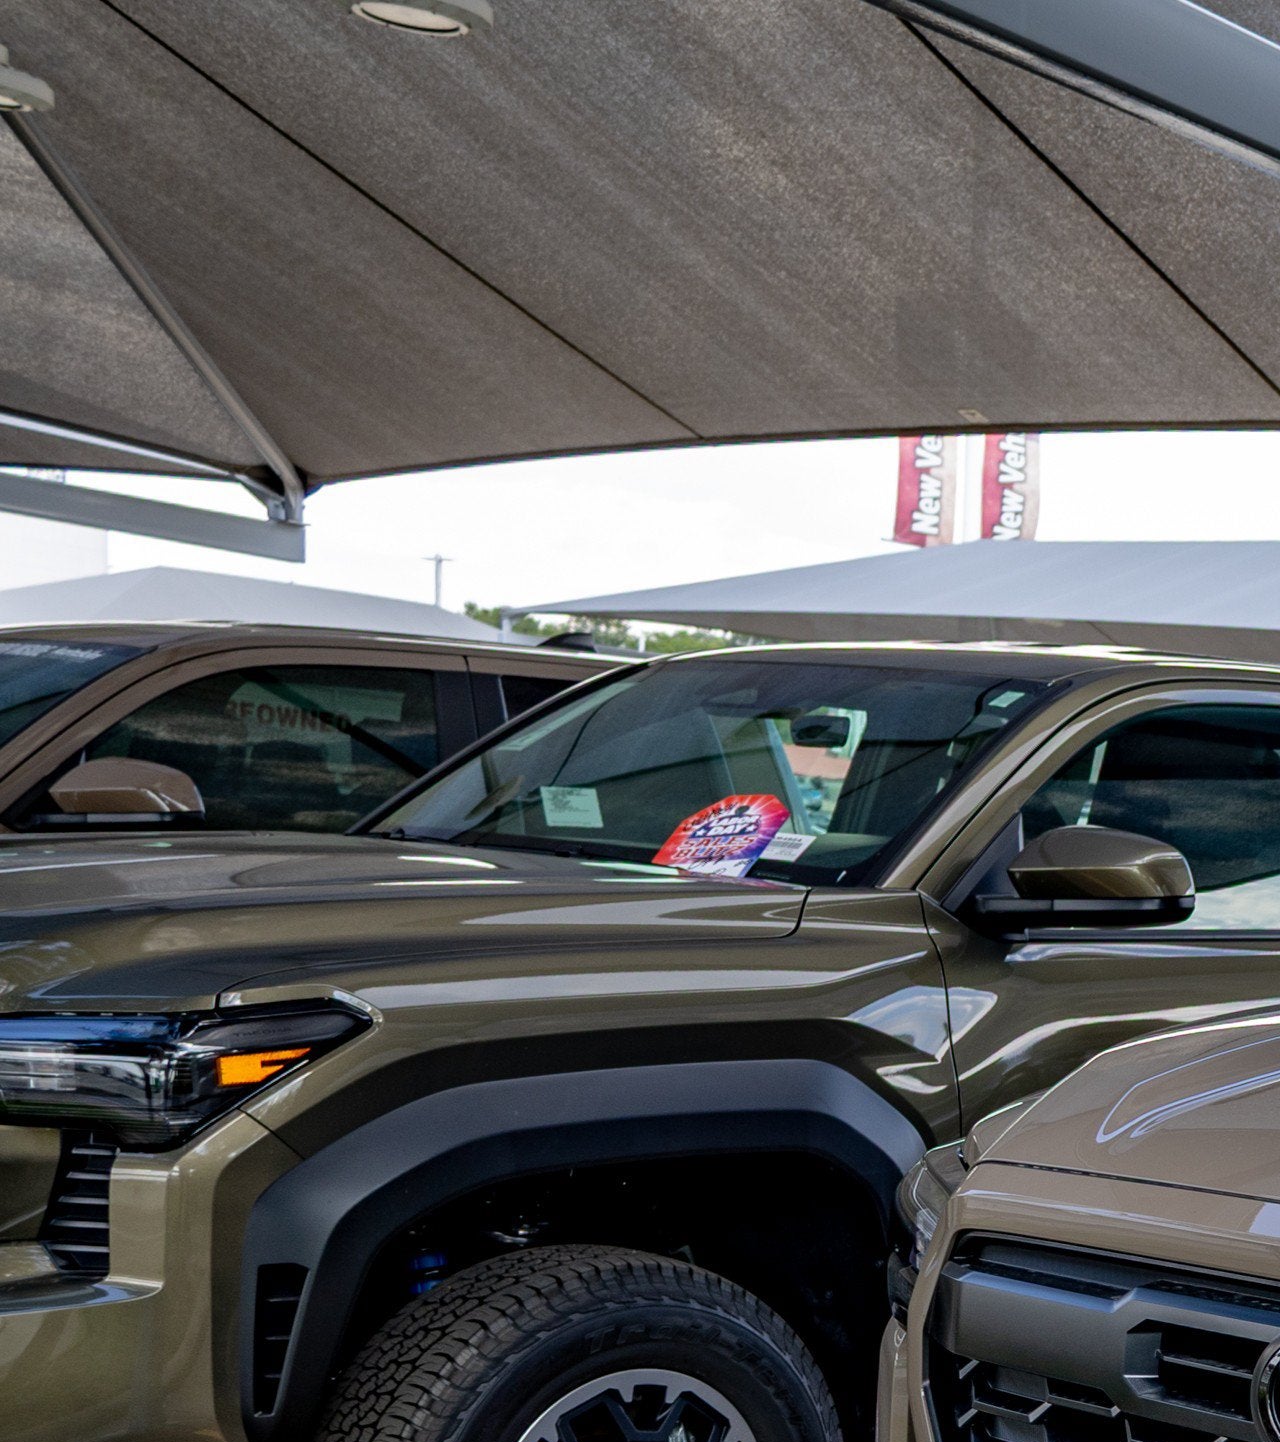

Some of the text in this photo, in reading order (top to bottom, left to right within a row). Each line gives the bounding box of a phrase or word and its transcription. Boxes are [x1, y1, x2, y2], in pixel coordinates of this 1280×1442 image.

[911, 472, 942, 536] New
[706, 824, 744, 837] DAY
[680, 836, 756, 849] SALES
